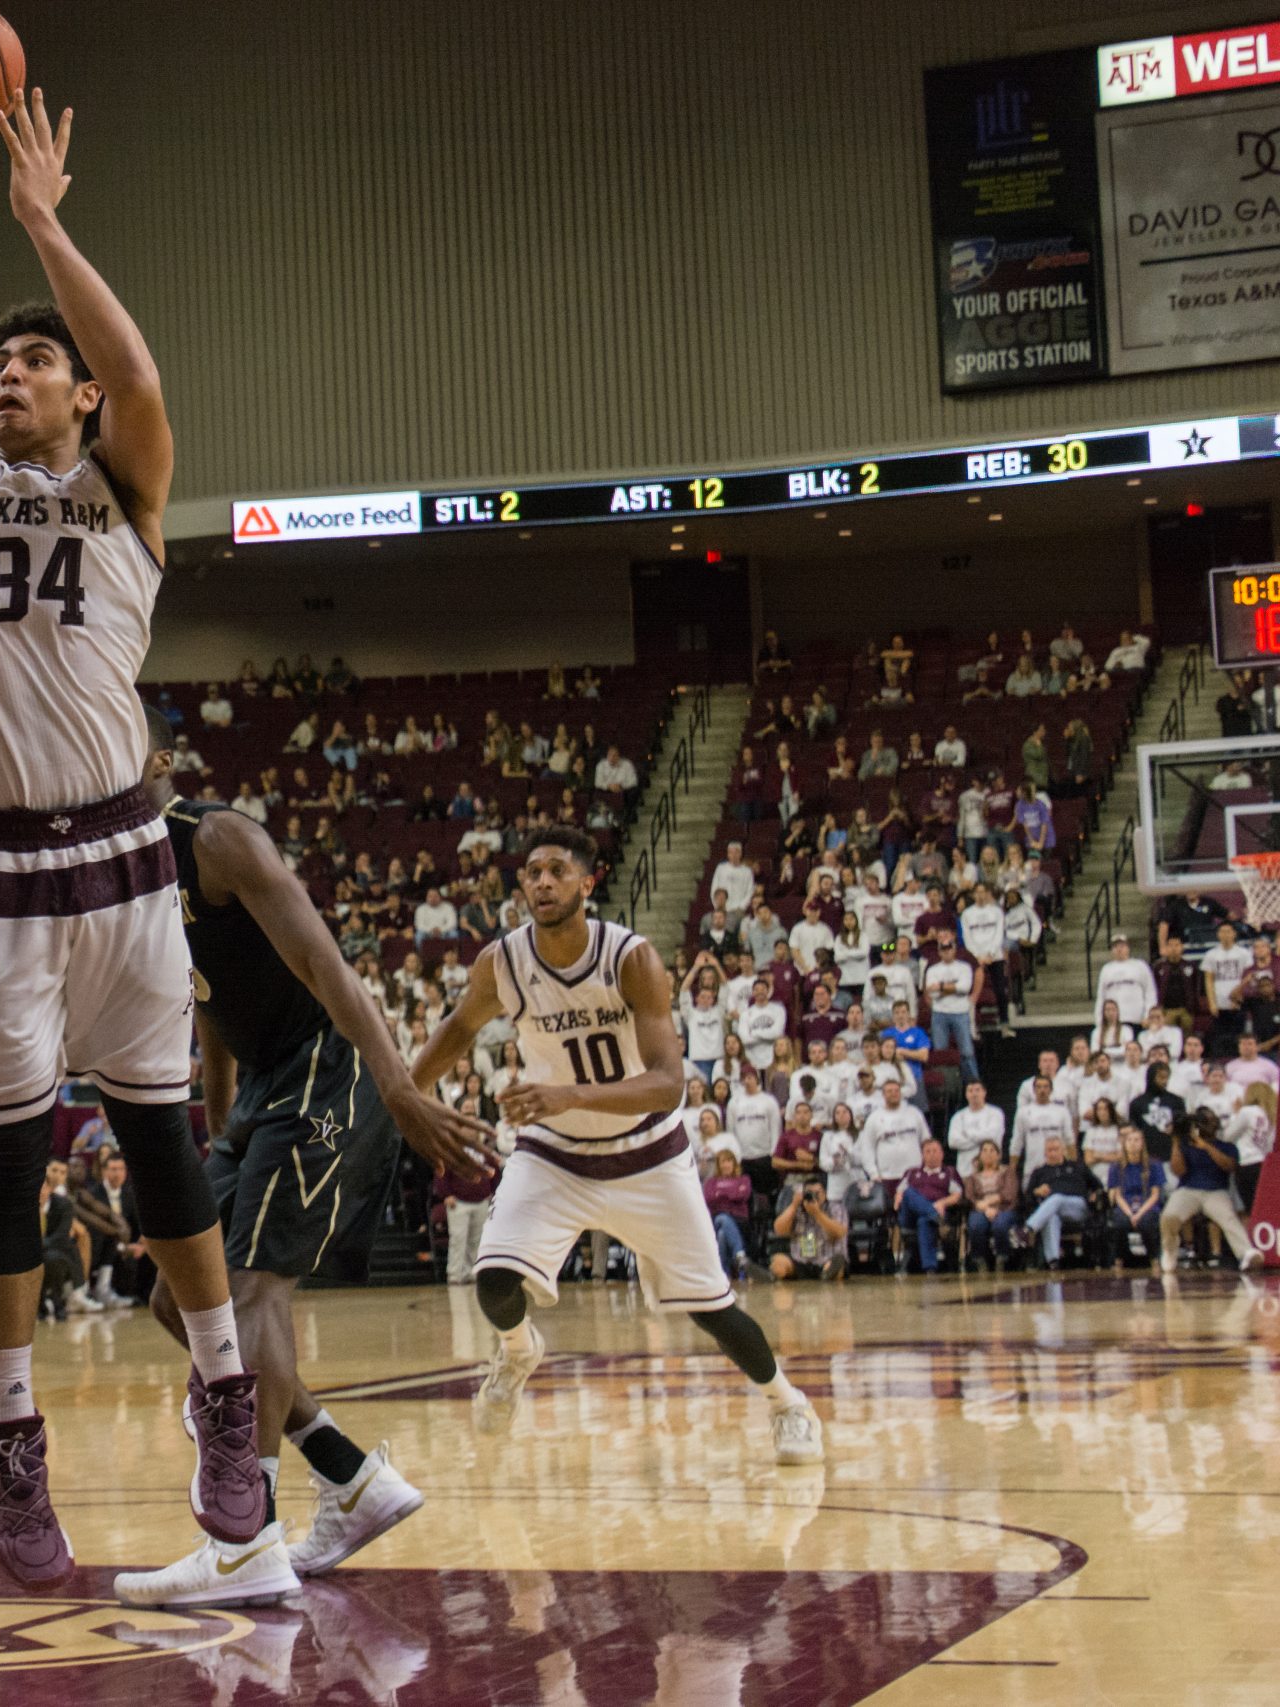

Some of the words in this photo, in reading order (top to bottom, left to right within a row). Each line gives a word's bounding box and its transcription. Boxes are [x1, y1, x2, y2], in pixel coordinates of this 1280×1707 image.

[1128, 204, 1221, 237] DAVID
[952, 292, 1001, 319] YOUR
[1006, 282, 1089, 313] OFFICIAL
[1168, 292, 1227, 312] Texas
[956, 308, 1090, 350] AGGIE
[955, 348, 1019, 375] SPORTS
[1024, 340, 1092, 369] STATION
[967, 450, 1032, 481] REB:
[1047, 439, 1088, 475] 30
[610, 484, 672, 513] AST:
[688, 477, 725, 509] 12
[788, 468, 851, 500] BLK:
[859, 462, 881, 495] 2
[59, 497, 110, 535] A&M
[286, 510, 355, 530] Moore
[360, 502, 415, 526] Feed
[434, 496, 494, 524] STL:
[499, 490, 520, 522] 2
[531, 1007, 591, 1033] TEXAS
[562, 1032, 626, 1086] 10
